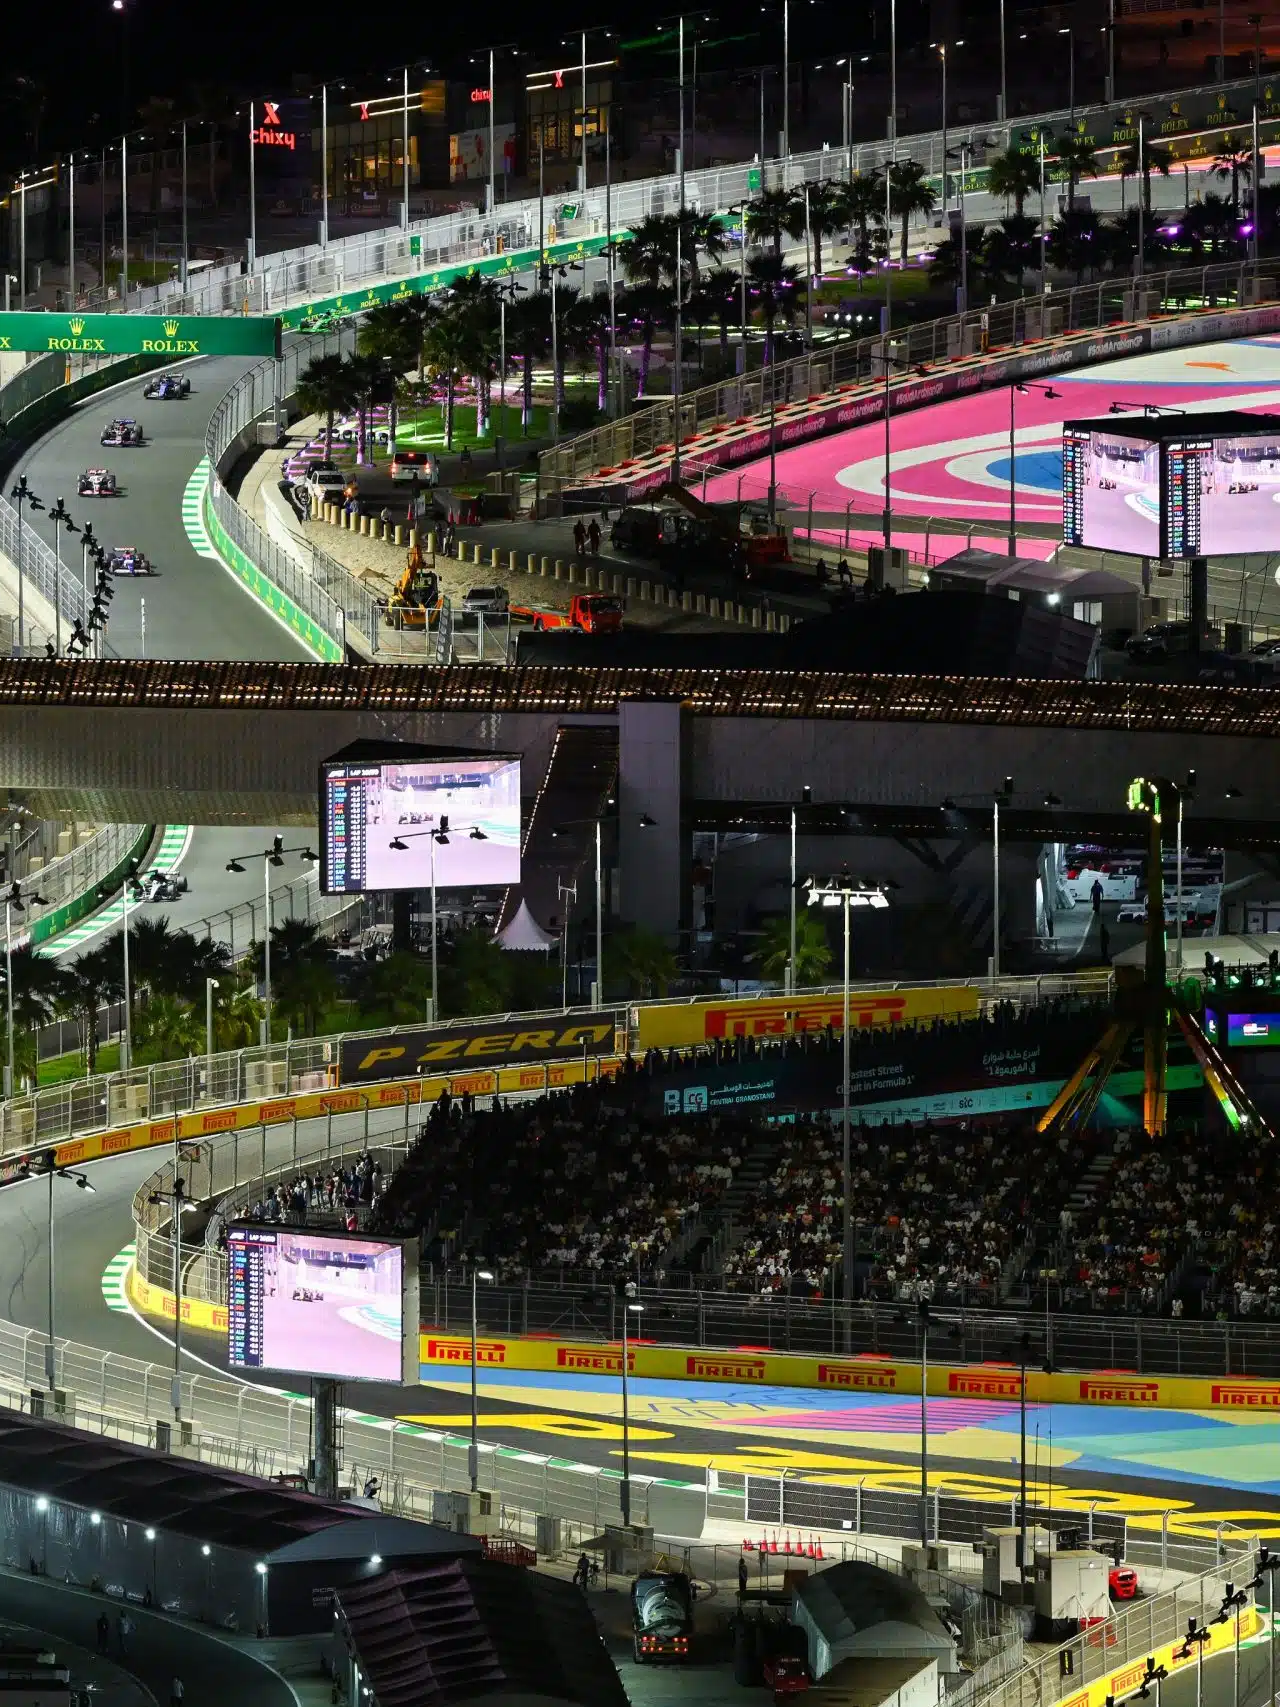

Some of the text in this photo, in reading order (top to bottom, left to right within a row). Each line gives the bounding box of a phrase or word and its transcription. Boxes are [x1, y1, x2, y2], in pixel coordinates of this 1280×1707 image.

[1161, 119, 1189, 133] ROLEX
[249, 127, 296, 150] chixy
[47, 337, 105, 351] ROLEX
[141, 339, 200, 353] ROLEX
[358, 1024, 614, 1070] P ZERO
[958, 1096, 974, 1109] stc
[203, 1111, 238, 1132] PIRELLI
[101, 1131, 131, 1151] PIRELLI
[428, 1340, 506, 1363] PIRELLI
[557, 1348, 636, 1371] PIRELLI
[686, 1356, 766, 1380] PIRELLI
[818, 1365, 897, 1388] PIRELLI
[948, 1373, 1028, 1395] PIRELLI
[1079, 1380, 1159, 1402] PIRELLI
